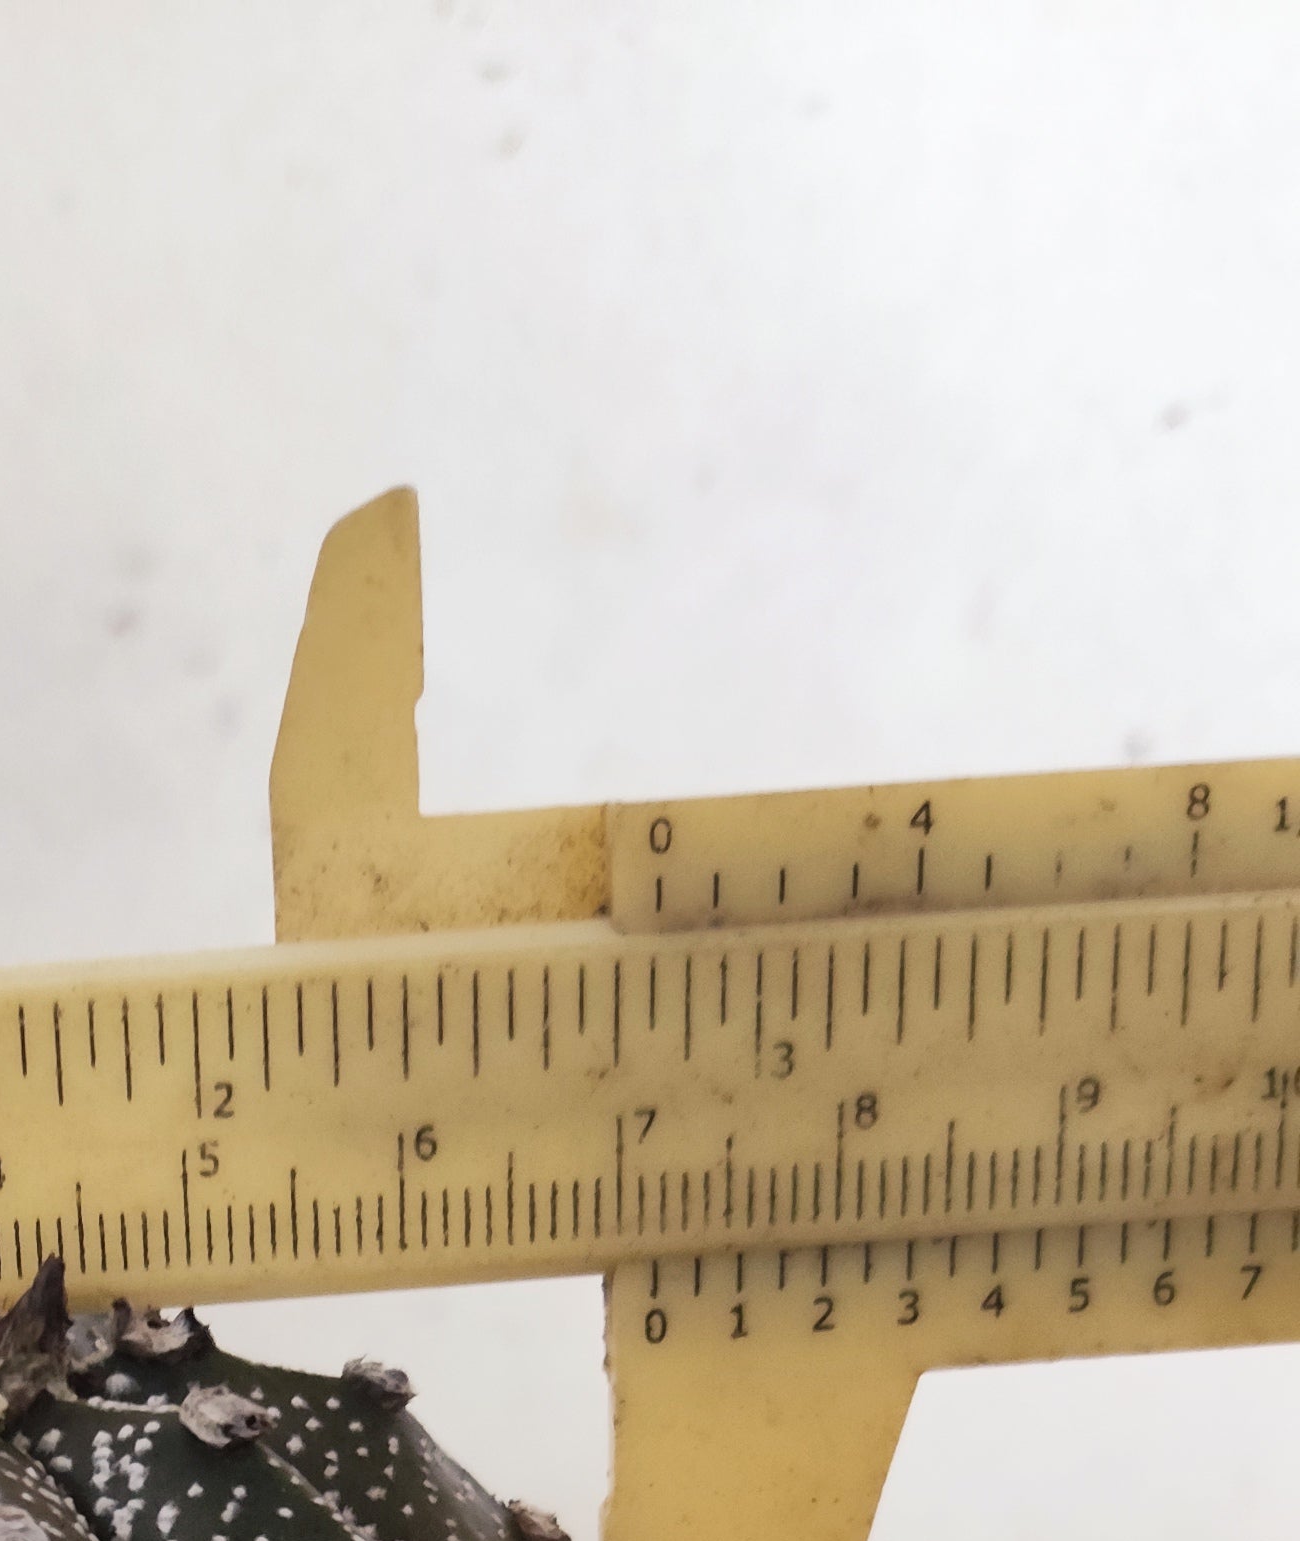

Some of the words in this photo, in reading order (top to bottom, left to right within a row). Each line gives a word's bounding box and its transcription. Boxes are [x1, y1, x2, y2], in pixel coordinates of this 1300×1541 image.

[648, 817, 673, 855] 0
[909, 800, 934, 837] 4
[1185, 783, 1211, 822] 8
[213, 1081, 235, 1119] 2
[773, 1040, 796, 1079] 3
[198, 1140, 220, 1178] 5
[413, 1123, 438, 1162] 6
[634, 1107, 658, 1144] 7
[854, 1091, 879, 1129] 8
[1076, 1075, 1102, 1113] 9
[644, 1307, 668, 1344] 0
[730, 1302, 748, 1340] 1
[812, 1295, 835, 1332] 2
[897, 1288, 921, 1326] 3
[981, 1283, 1006, 1318] 4
[1069, 1276, 1091, 1313] 5
[1152, 1268, 1177, 1306] 6
[1240, 1263, 1265, 1300] 7
